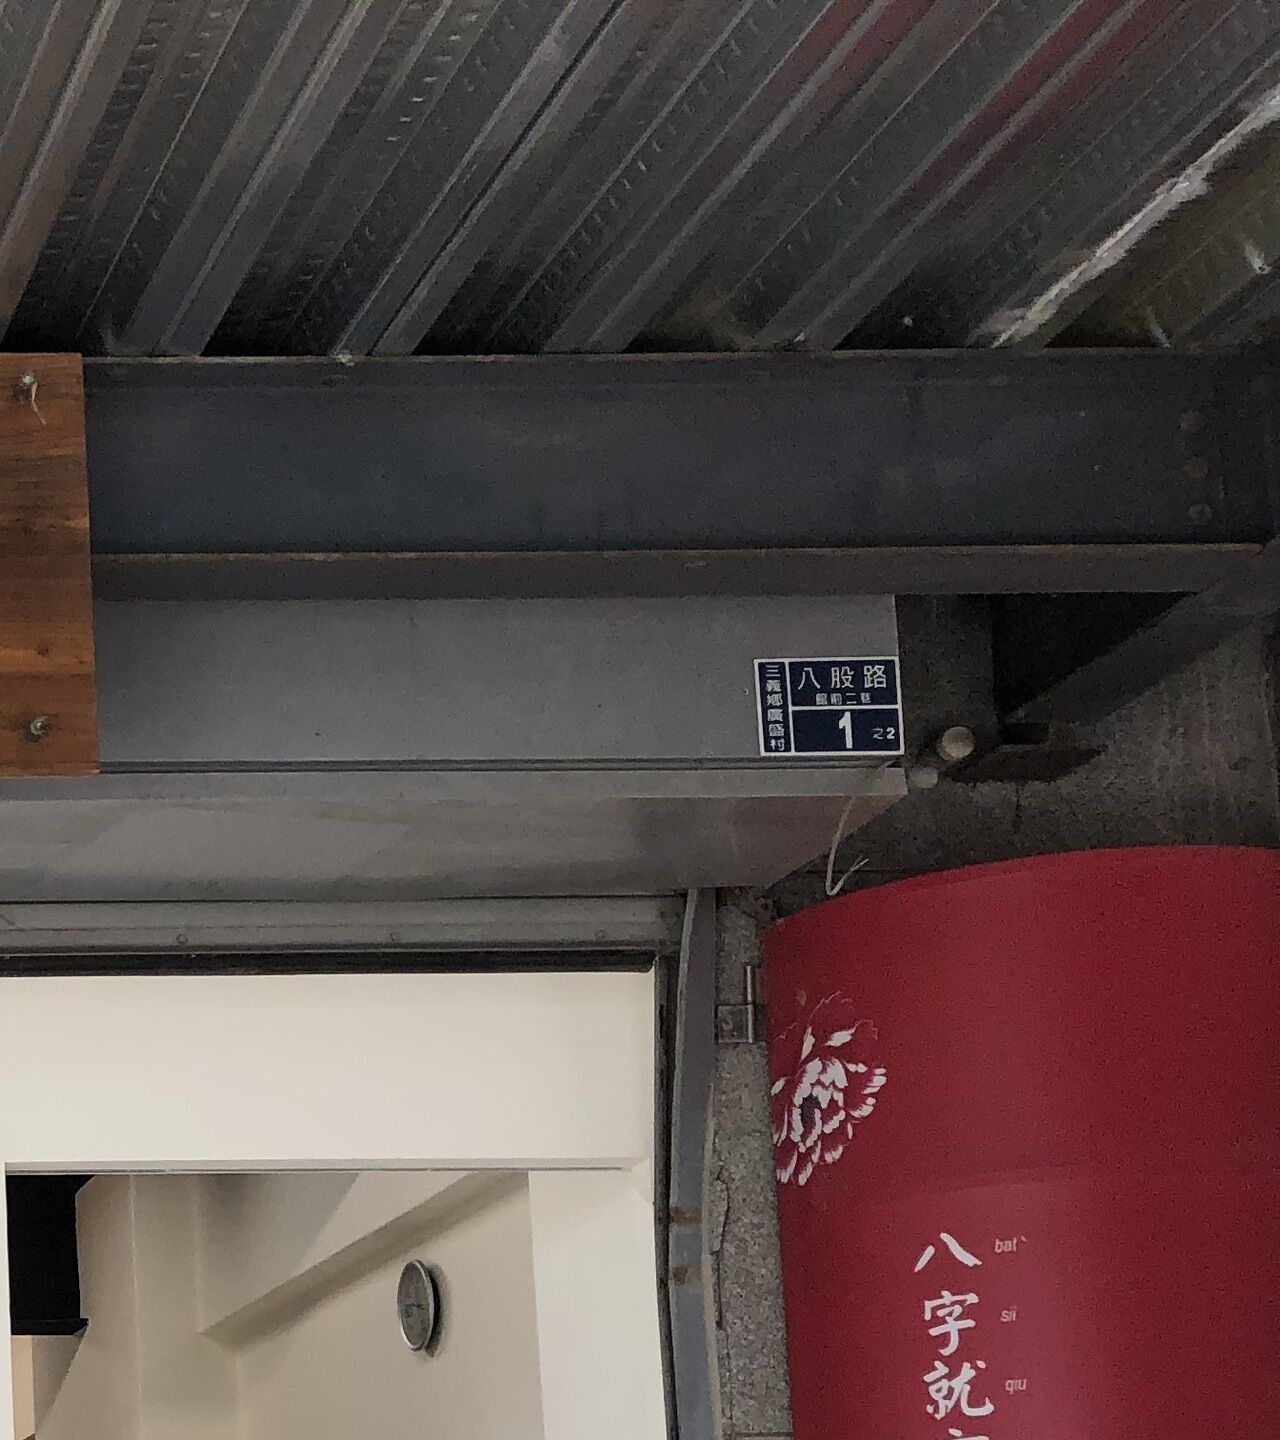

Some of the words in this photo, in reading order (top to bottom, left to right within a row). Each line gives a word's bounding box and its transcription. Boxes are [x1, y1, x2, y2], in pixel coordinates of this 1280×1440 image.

[797, 664, 887, 690] 八股路
[838, 711, 853, 749] 1
